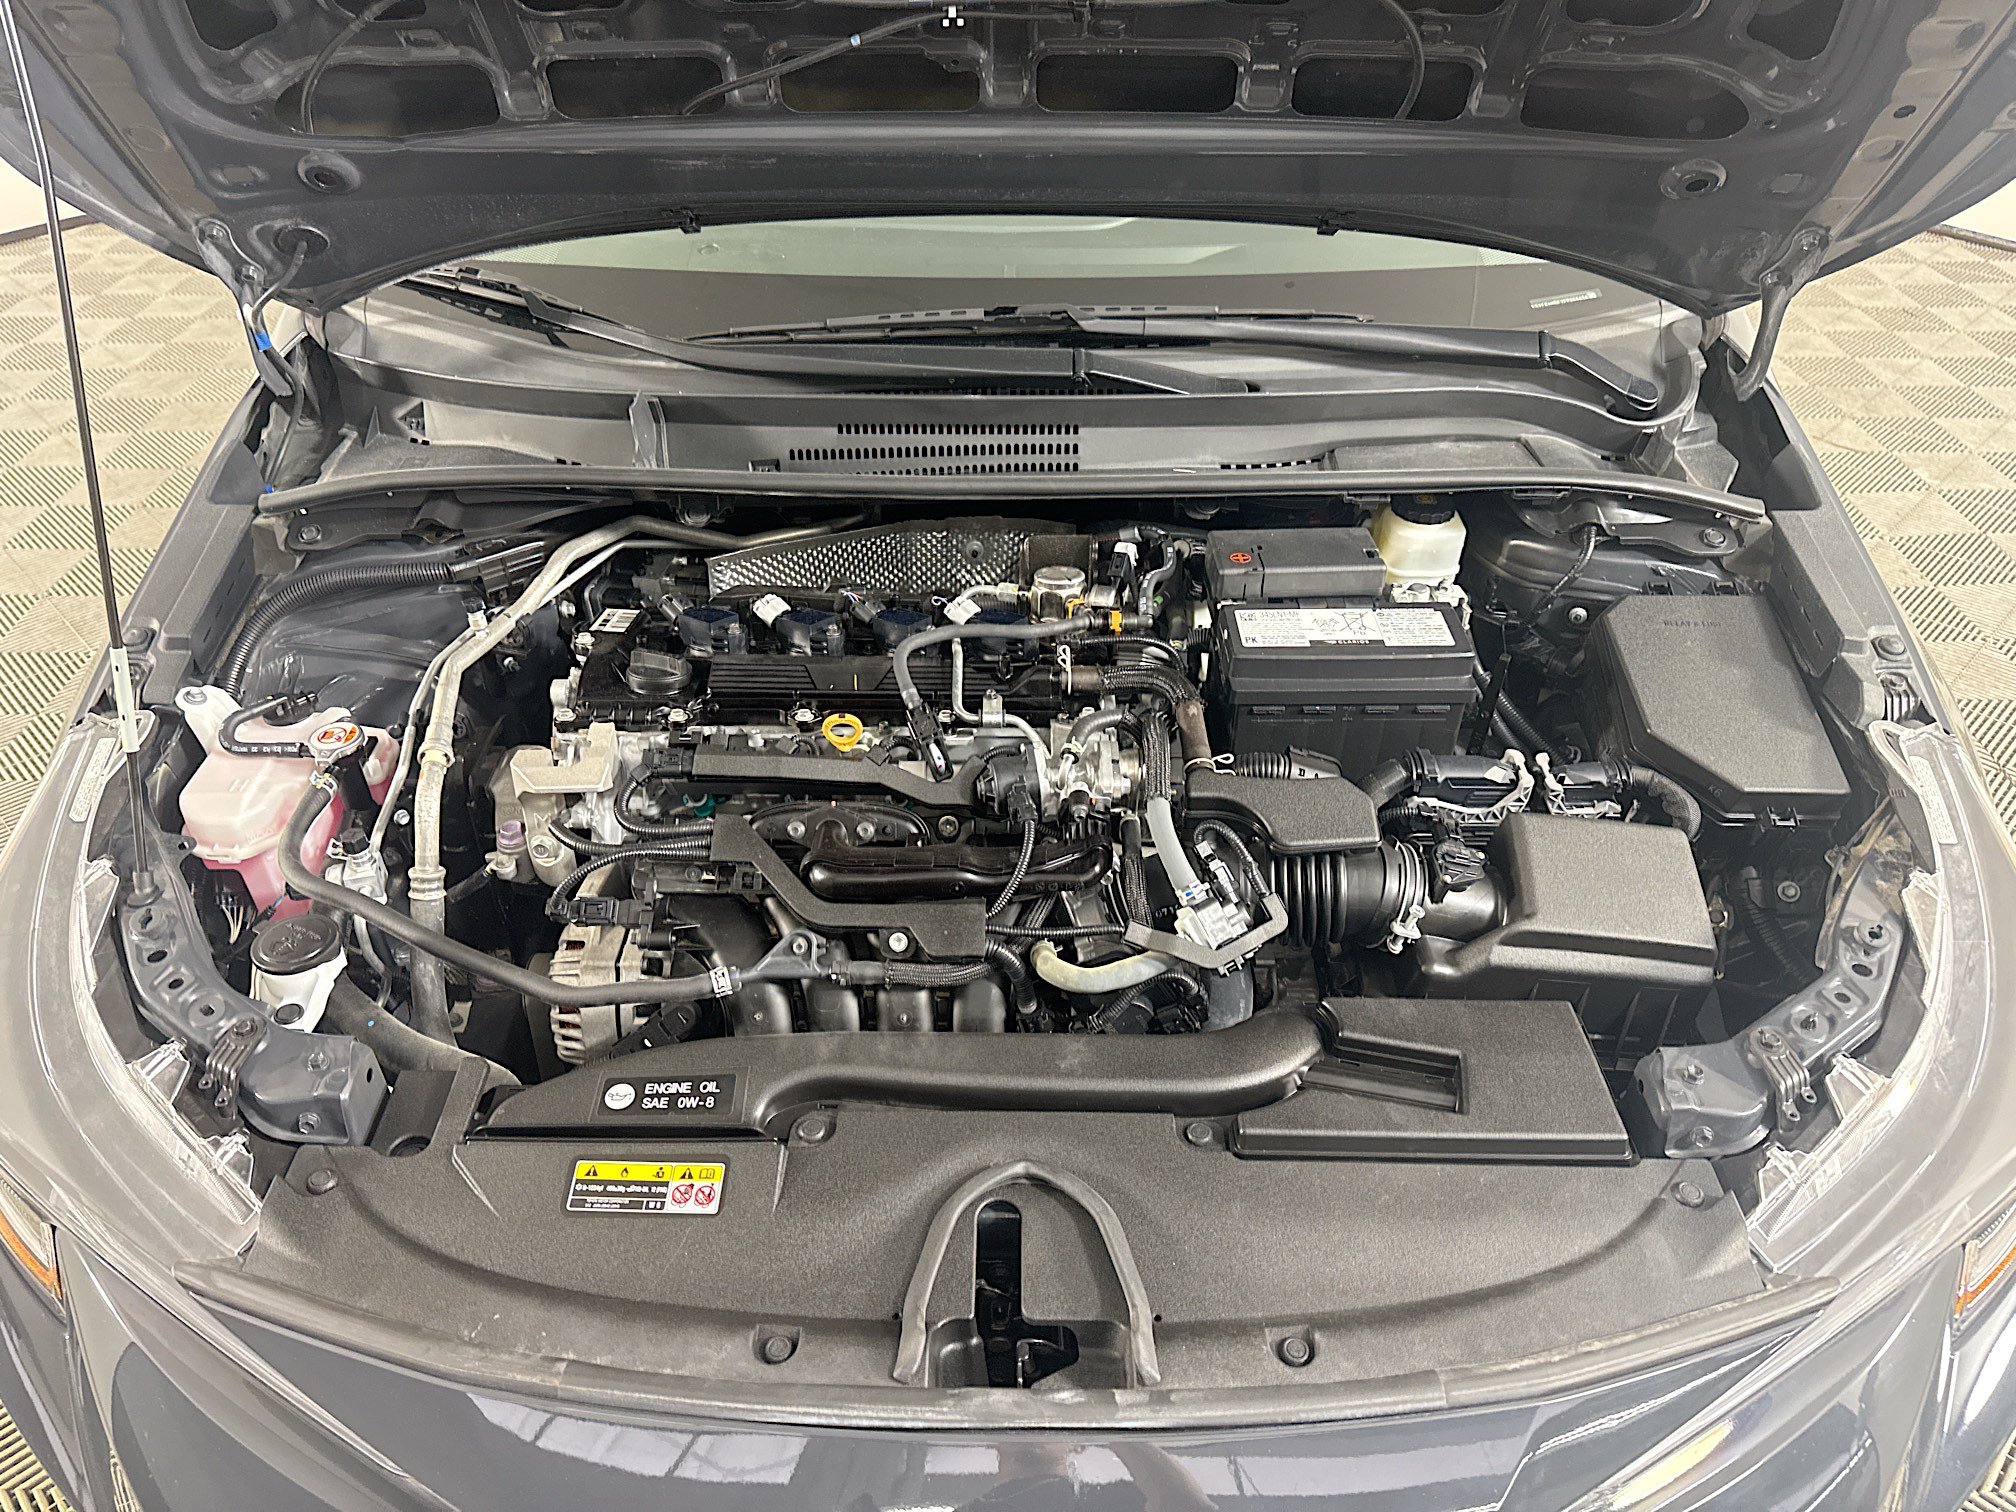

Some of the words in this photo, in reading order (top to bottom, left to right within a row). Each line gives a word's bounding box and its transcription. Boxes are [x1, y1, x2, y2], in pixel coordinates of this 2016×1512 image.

[644, 1082, 692, 1094] ENGINE
[699, 1081, 720, 1093] OIL
[641, 1097, 669, 1109] SAE
[677, 1096, 714, 1108] 0W-8
